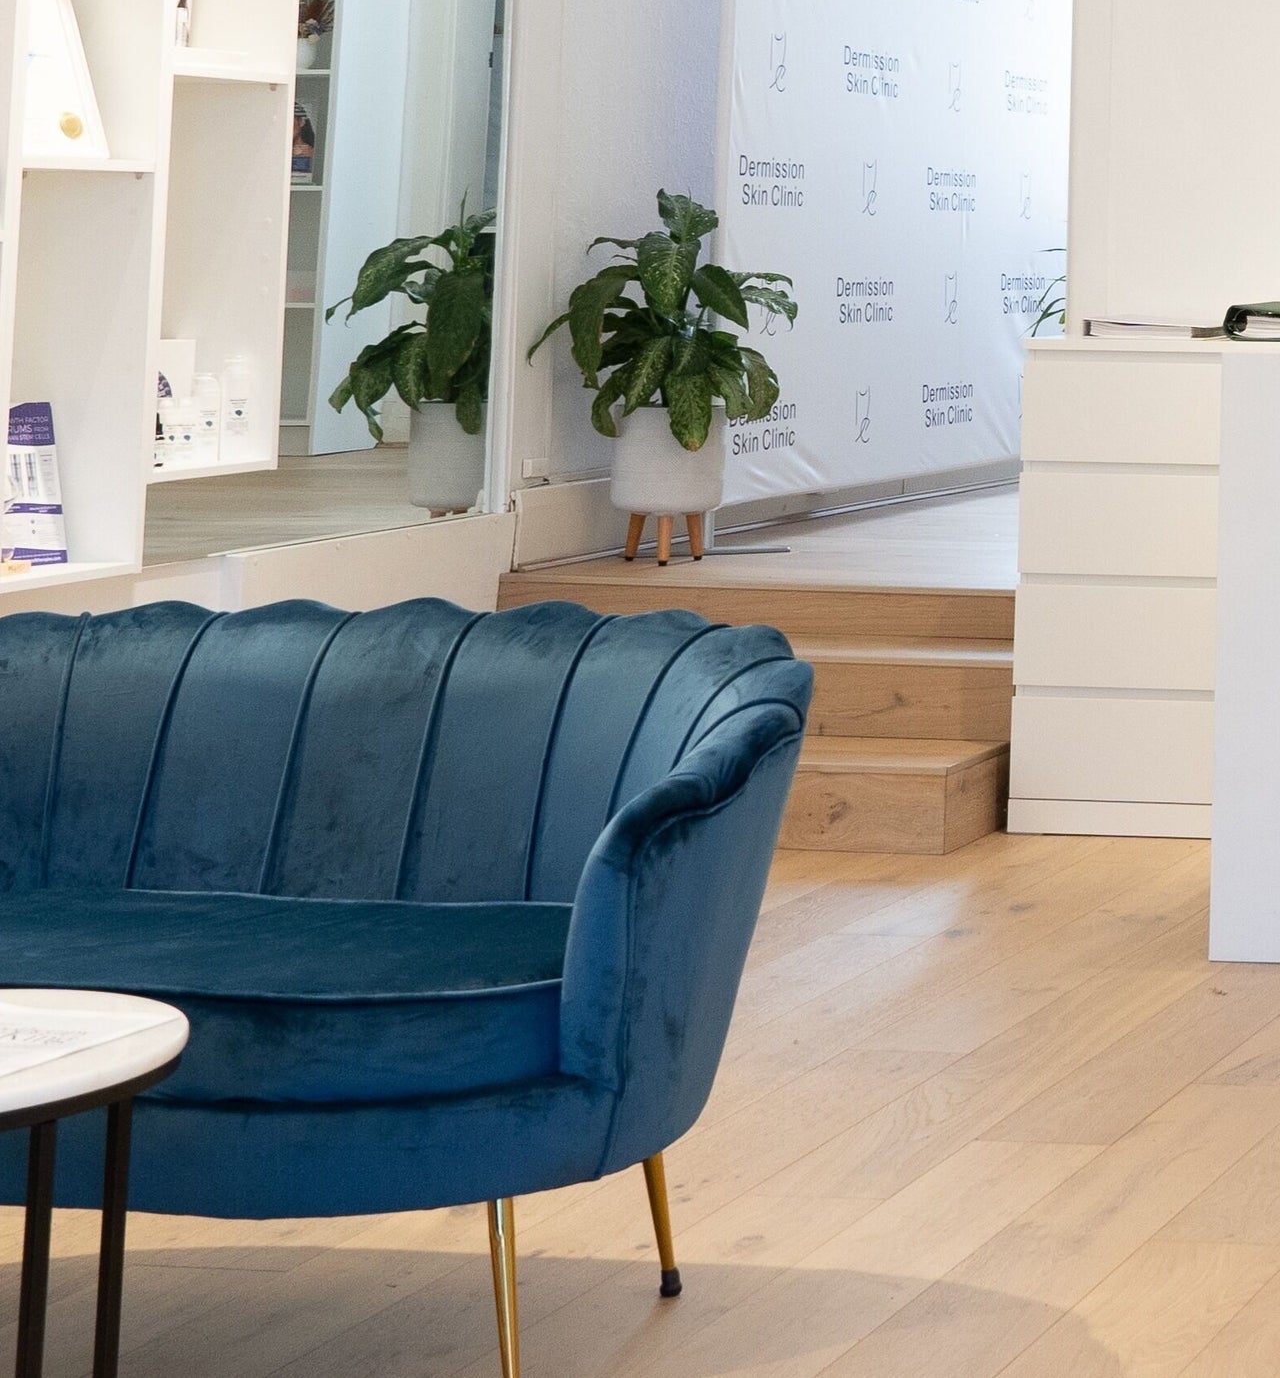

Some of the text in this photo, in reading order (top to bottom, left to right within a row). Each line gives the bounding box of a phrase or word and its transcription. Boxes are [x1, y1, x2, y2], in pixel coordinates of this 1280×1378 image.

[844, 45, 900, 73] Dermission
[846, 72, 871, 96] Skin
[739, 154, 805, 180] Dermission
[927, 167, 977, 189] Dermission
[742, 182, 804, 207] Skin Clinic
[929, 191, 976, 213] Skin Clinic
[836, 276, 894, 299] Dermission
[1000, 273, 1046, 291] Dermission
[839, 301, 894, 324] Skin Clinic
[1002, 296, 1020, 314] Skin
[922, 380, 974, 404] Dermission
[925, 404, 973, 428] Skin Clinic
[732, 427, 796, 456] Skin Clinic
